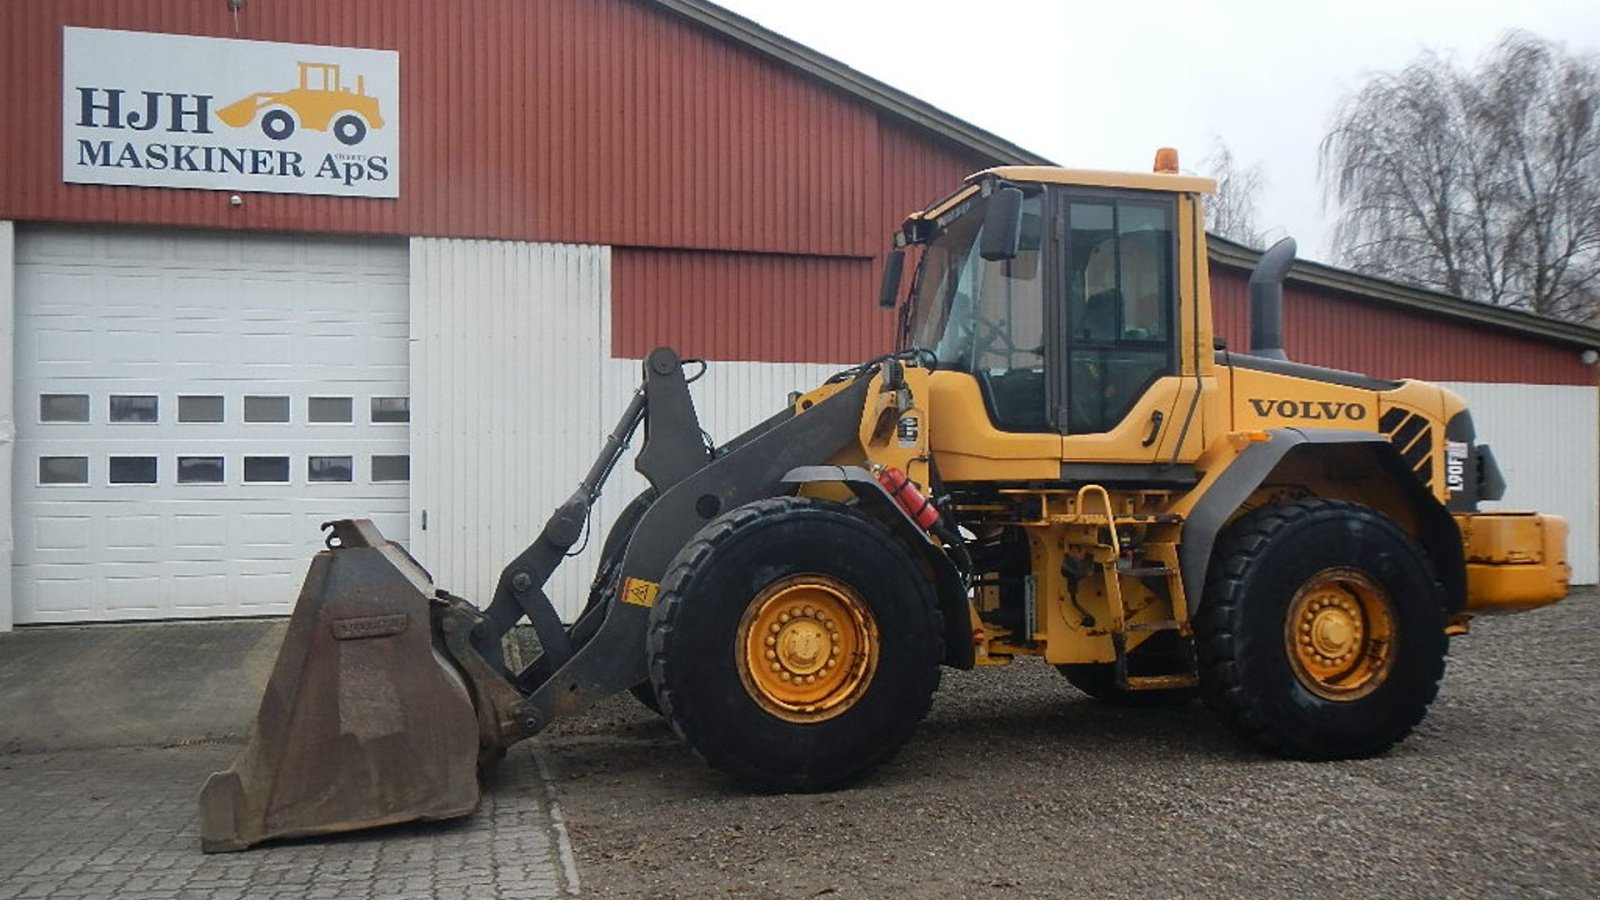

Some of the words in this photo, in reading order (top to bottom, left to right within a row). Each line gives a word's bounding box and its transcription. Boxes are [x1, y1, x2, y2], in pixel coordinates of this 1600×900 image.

[75, 86, 213, 134] HJH
[76, 138, 305, 177] MASKINER
[314, 153, 388, 187] ApS
[1248, 398, 1366, 421] VOLVO
